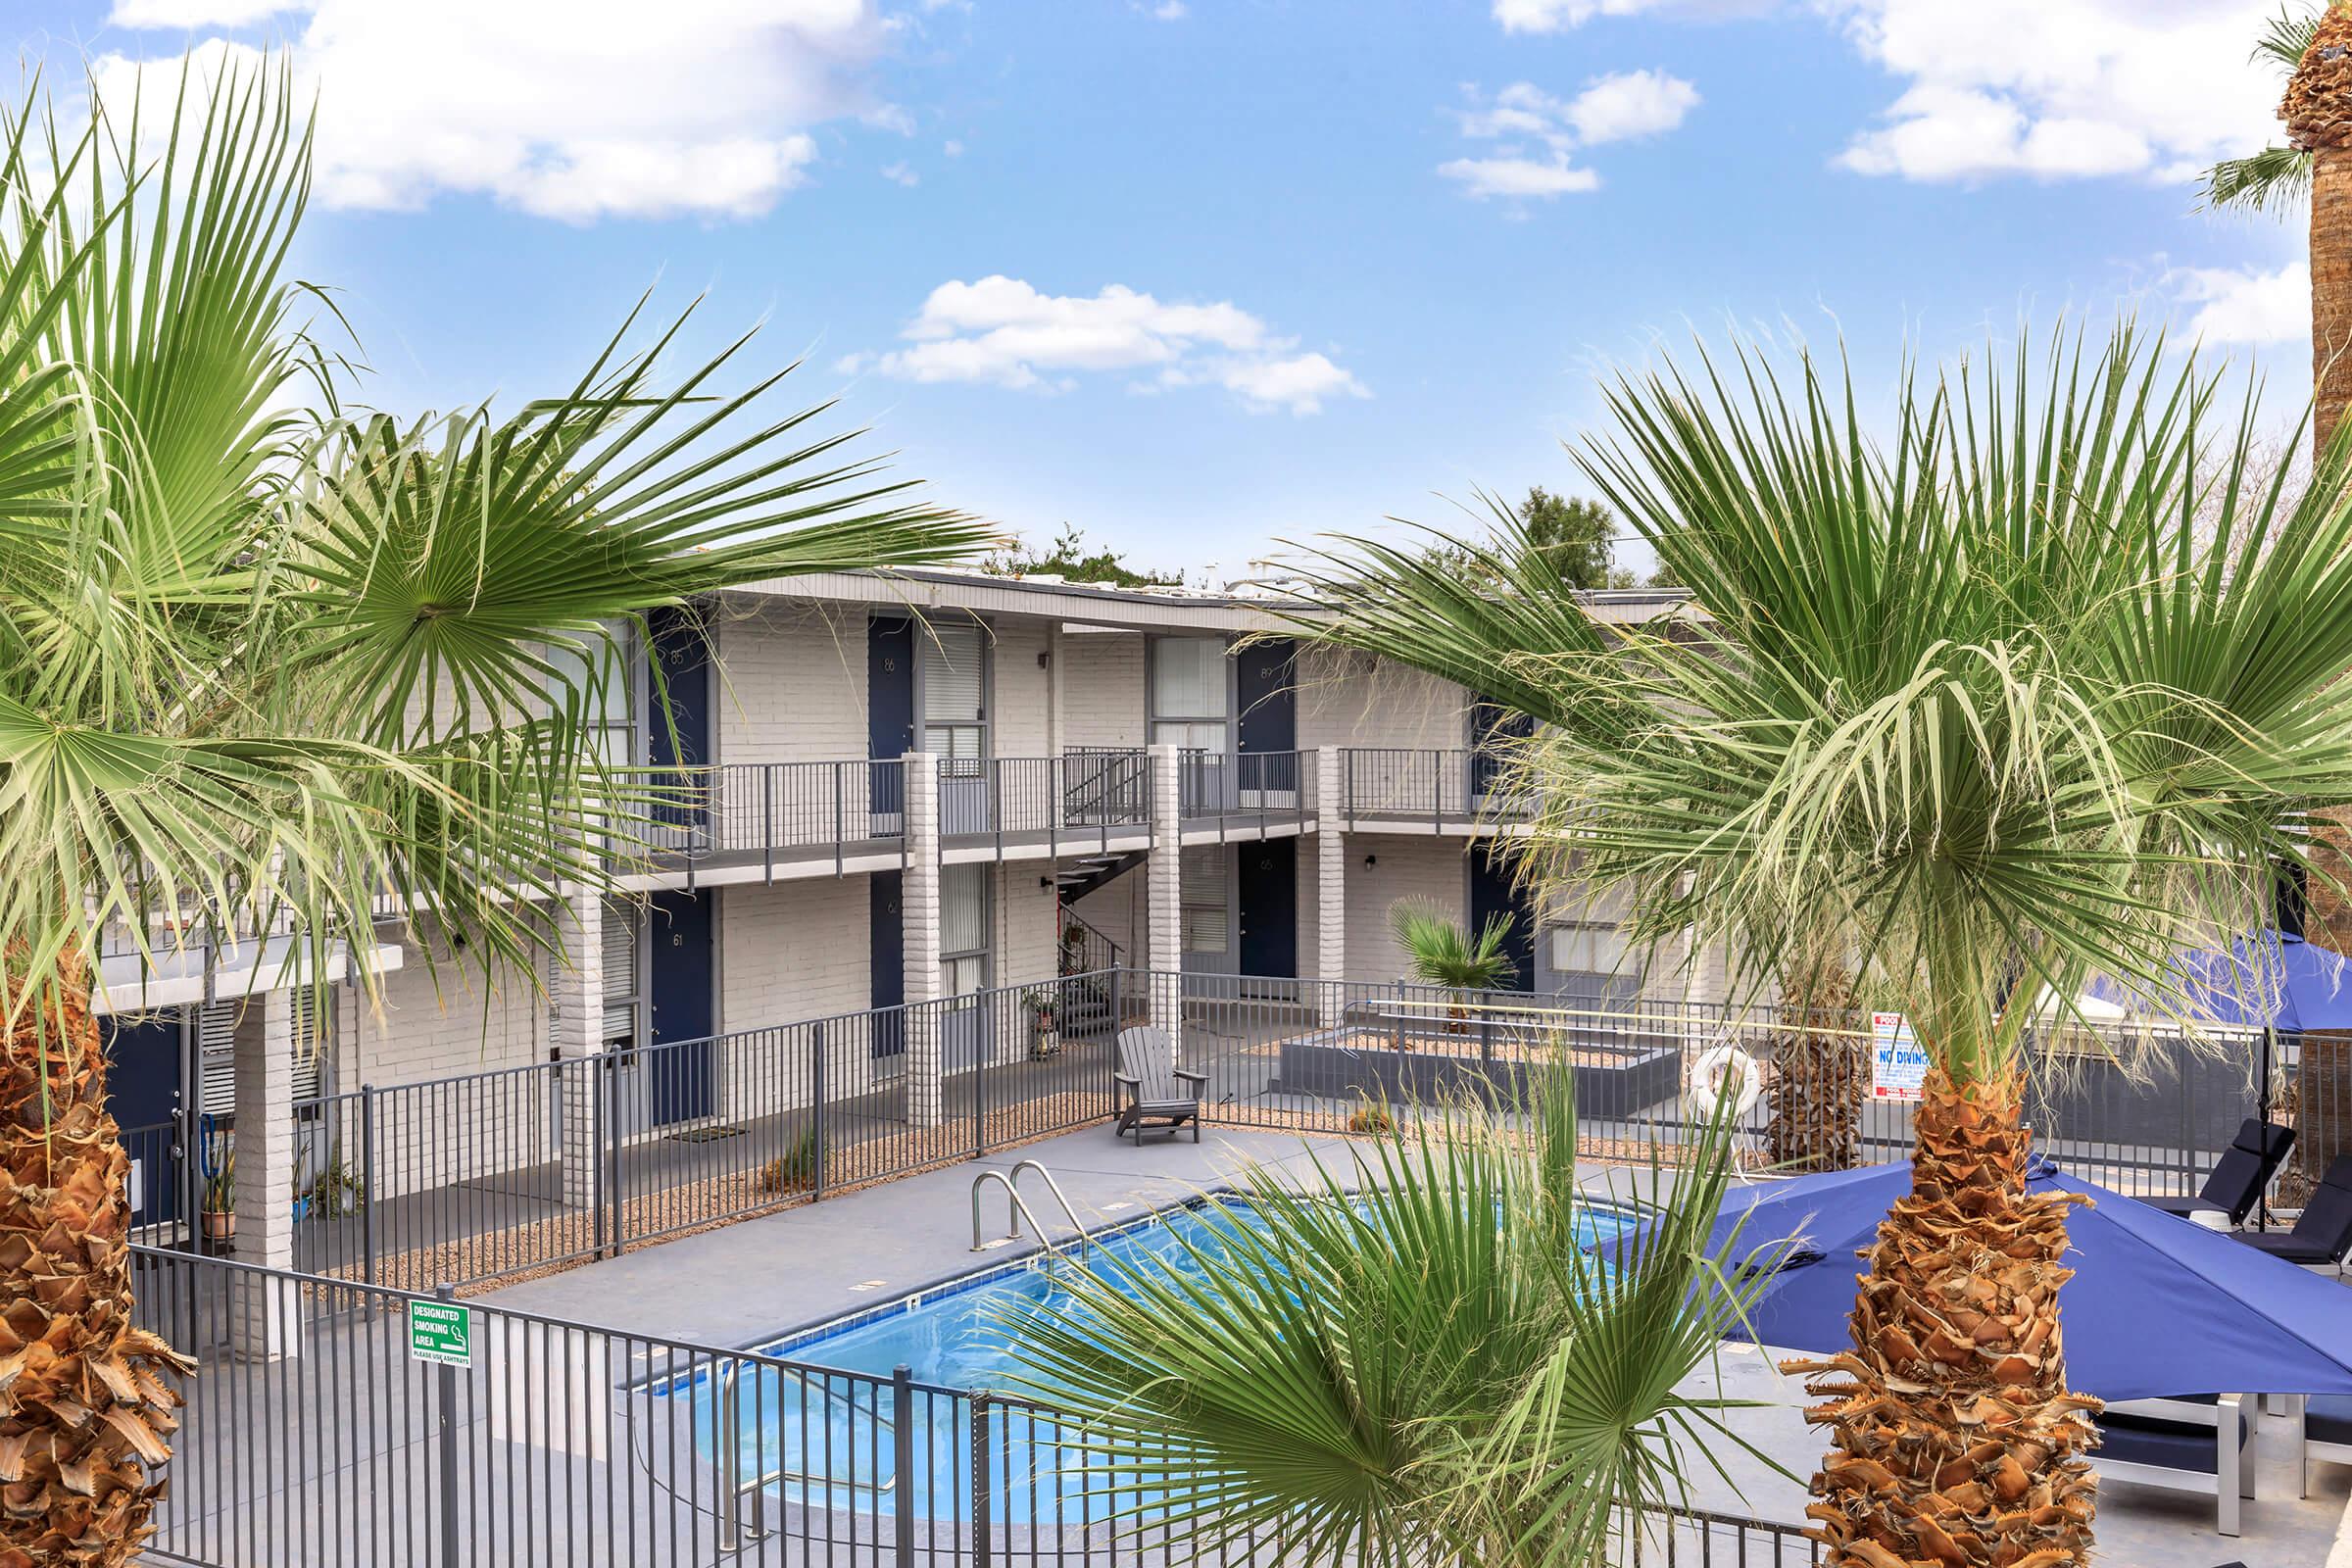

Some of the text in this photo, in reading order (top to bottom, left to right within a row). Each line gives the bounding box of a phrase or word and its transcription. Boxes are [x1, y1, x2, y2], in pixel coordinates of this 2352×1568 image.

[670, 650, 684, 664] 85
[884, 658, 895, 672] 86
[1260, 666, 1272, 679] 89
[673, 933, 683, 947] 61
[1880, 1051, 1929, 1064] NO DIVING
[414, 1305, 460, 1320] DESIGNATED
[415, 1320, 448, 1335] SMOKING
[415, 1334, 435, 1348] AREA
[414, 1349, 431, 1359] PLEASE
[444, 1355, 468, 1364] ASHTRAYS
